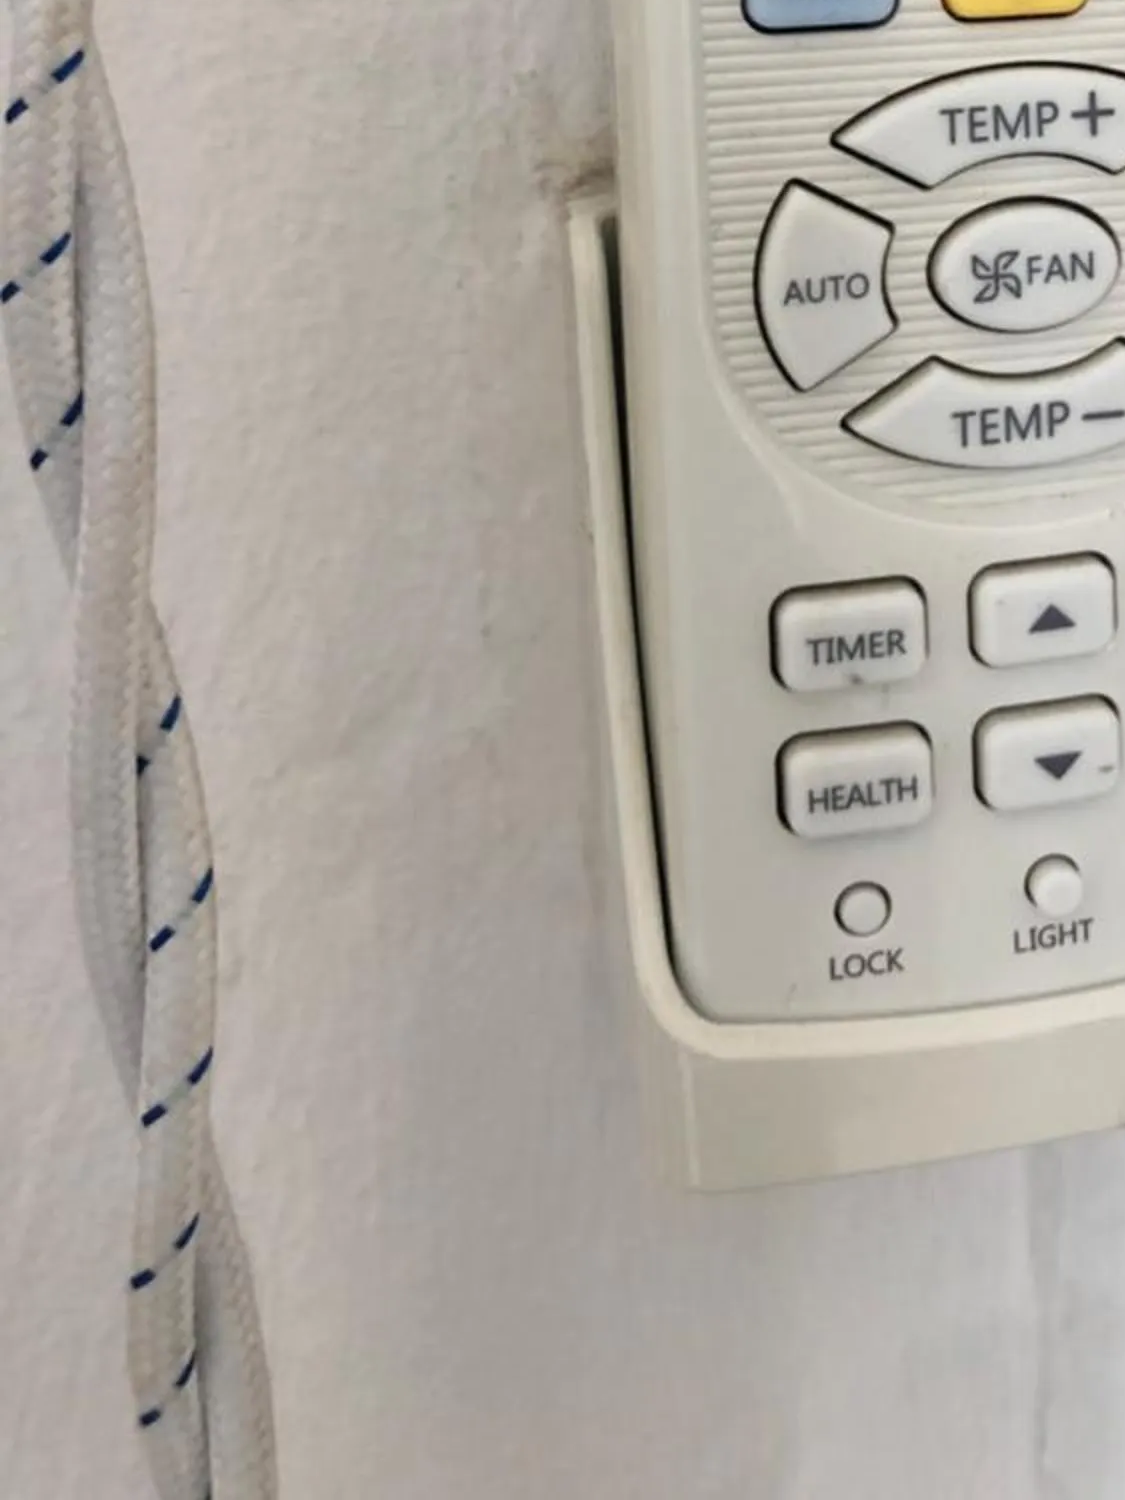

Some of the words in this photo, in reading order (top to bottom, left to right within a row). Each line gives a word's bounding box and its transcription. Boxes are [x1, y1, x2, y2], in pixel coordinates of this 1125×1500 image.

[1026, 251, 1095, 285] FAN
[783, 272, 870, 305] AUTO
[807, 630, 907, 665] TIMER
[808, 777, 918, 814] HEALTH
[1013, 920, 1093, 954] LIGHT
[829, 949, 904, 981] LOCK
